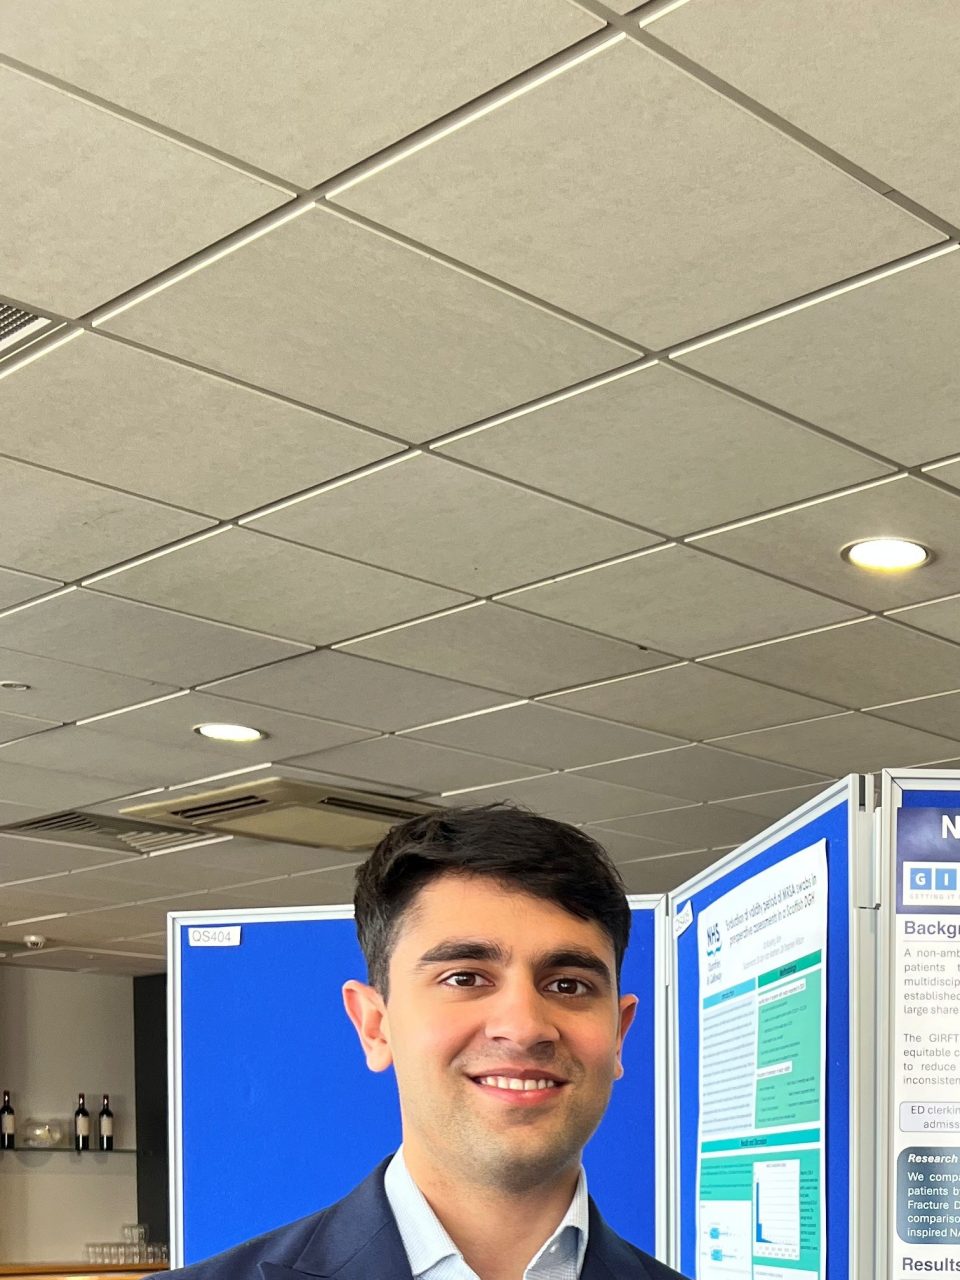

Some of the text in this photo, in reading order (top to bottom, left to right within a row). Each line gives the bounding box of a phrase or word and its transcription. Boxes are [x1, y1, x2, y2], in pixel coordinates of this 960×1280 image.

[192, 930, 231, 943] QS404
[707, 922, 721, 947] NHS
[910, 1105, 926, 1115] ED
[907, 1153, 958, 1163] Research
